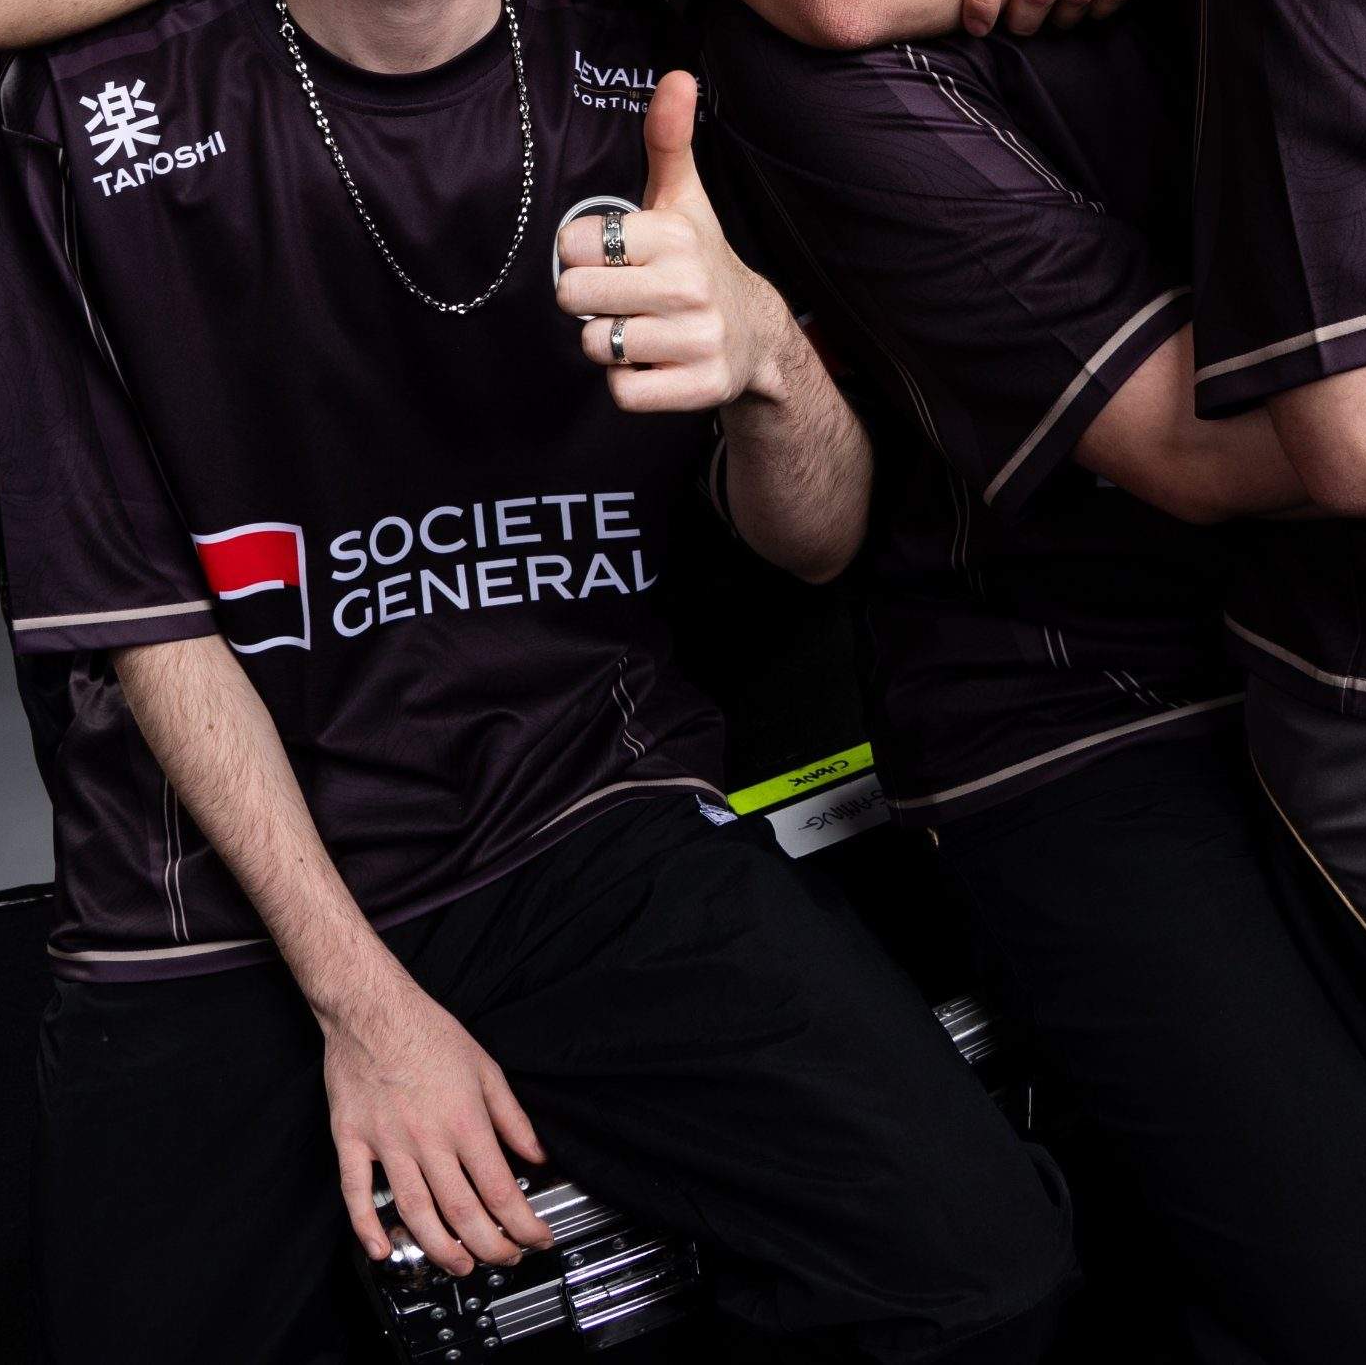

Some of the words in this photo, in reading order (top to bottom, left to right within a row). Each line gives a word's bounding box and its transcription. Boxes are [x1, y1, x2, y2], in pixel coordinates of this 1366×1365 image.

[79, 79, 161, 166] 楽
[92, 130, 227, 197] TANOSHI
[329, 491, 641, 581] SOCIETE
